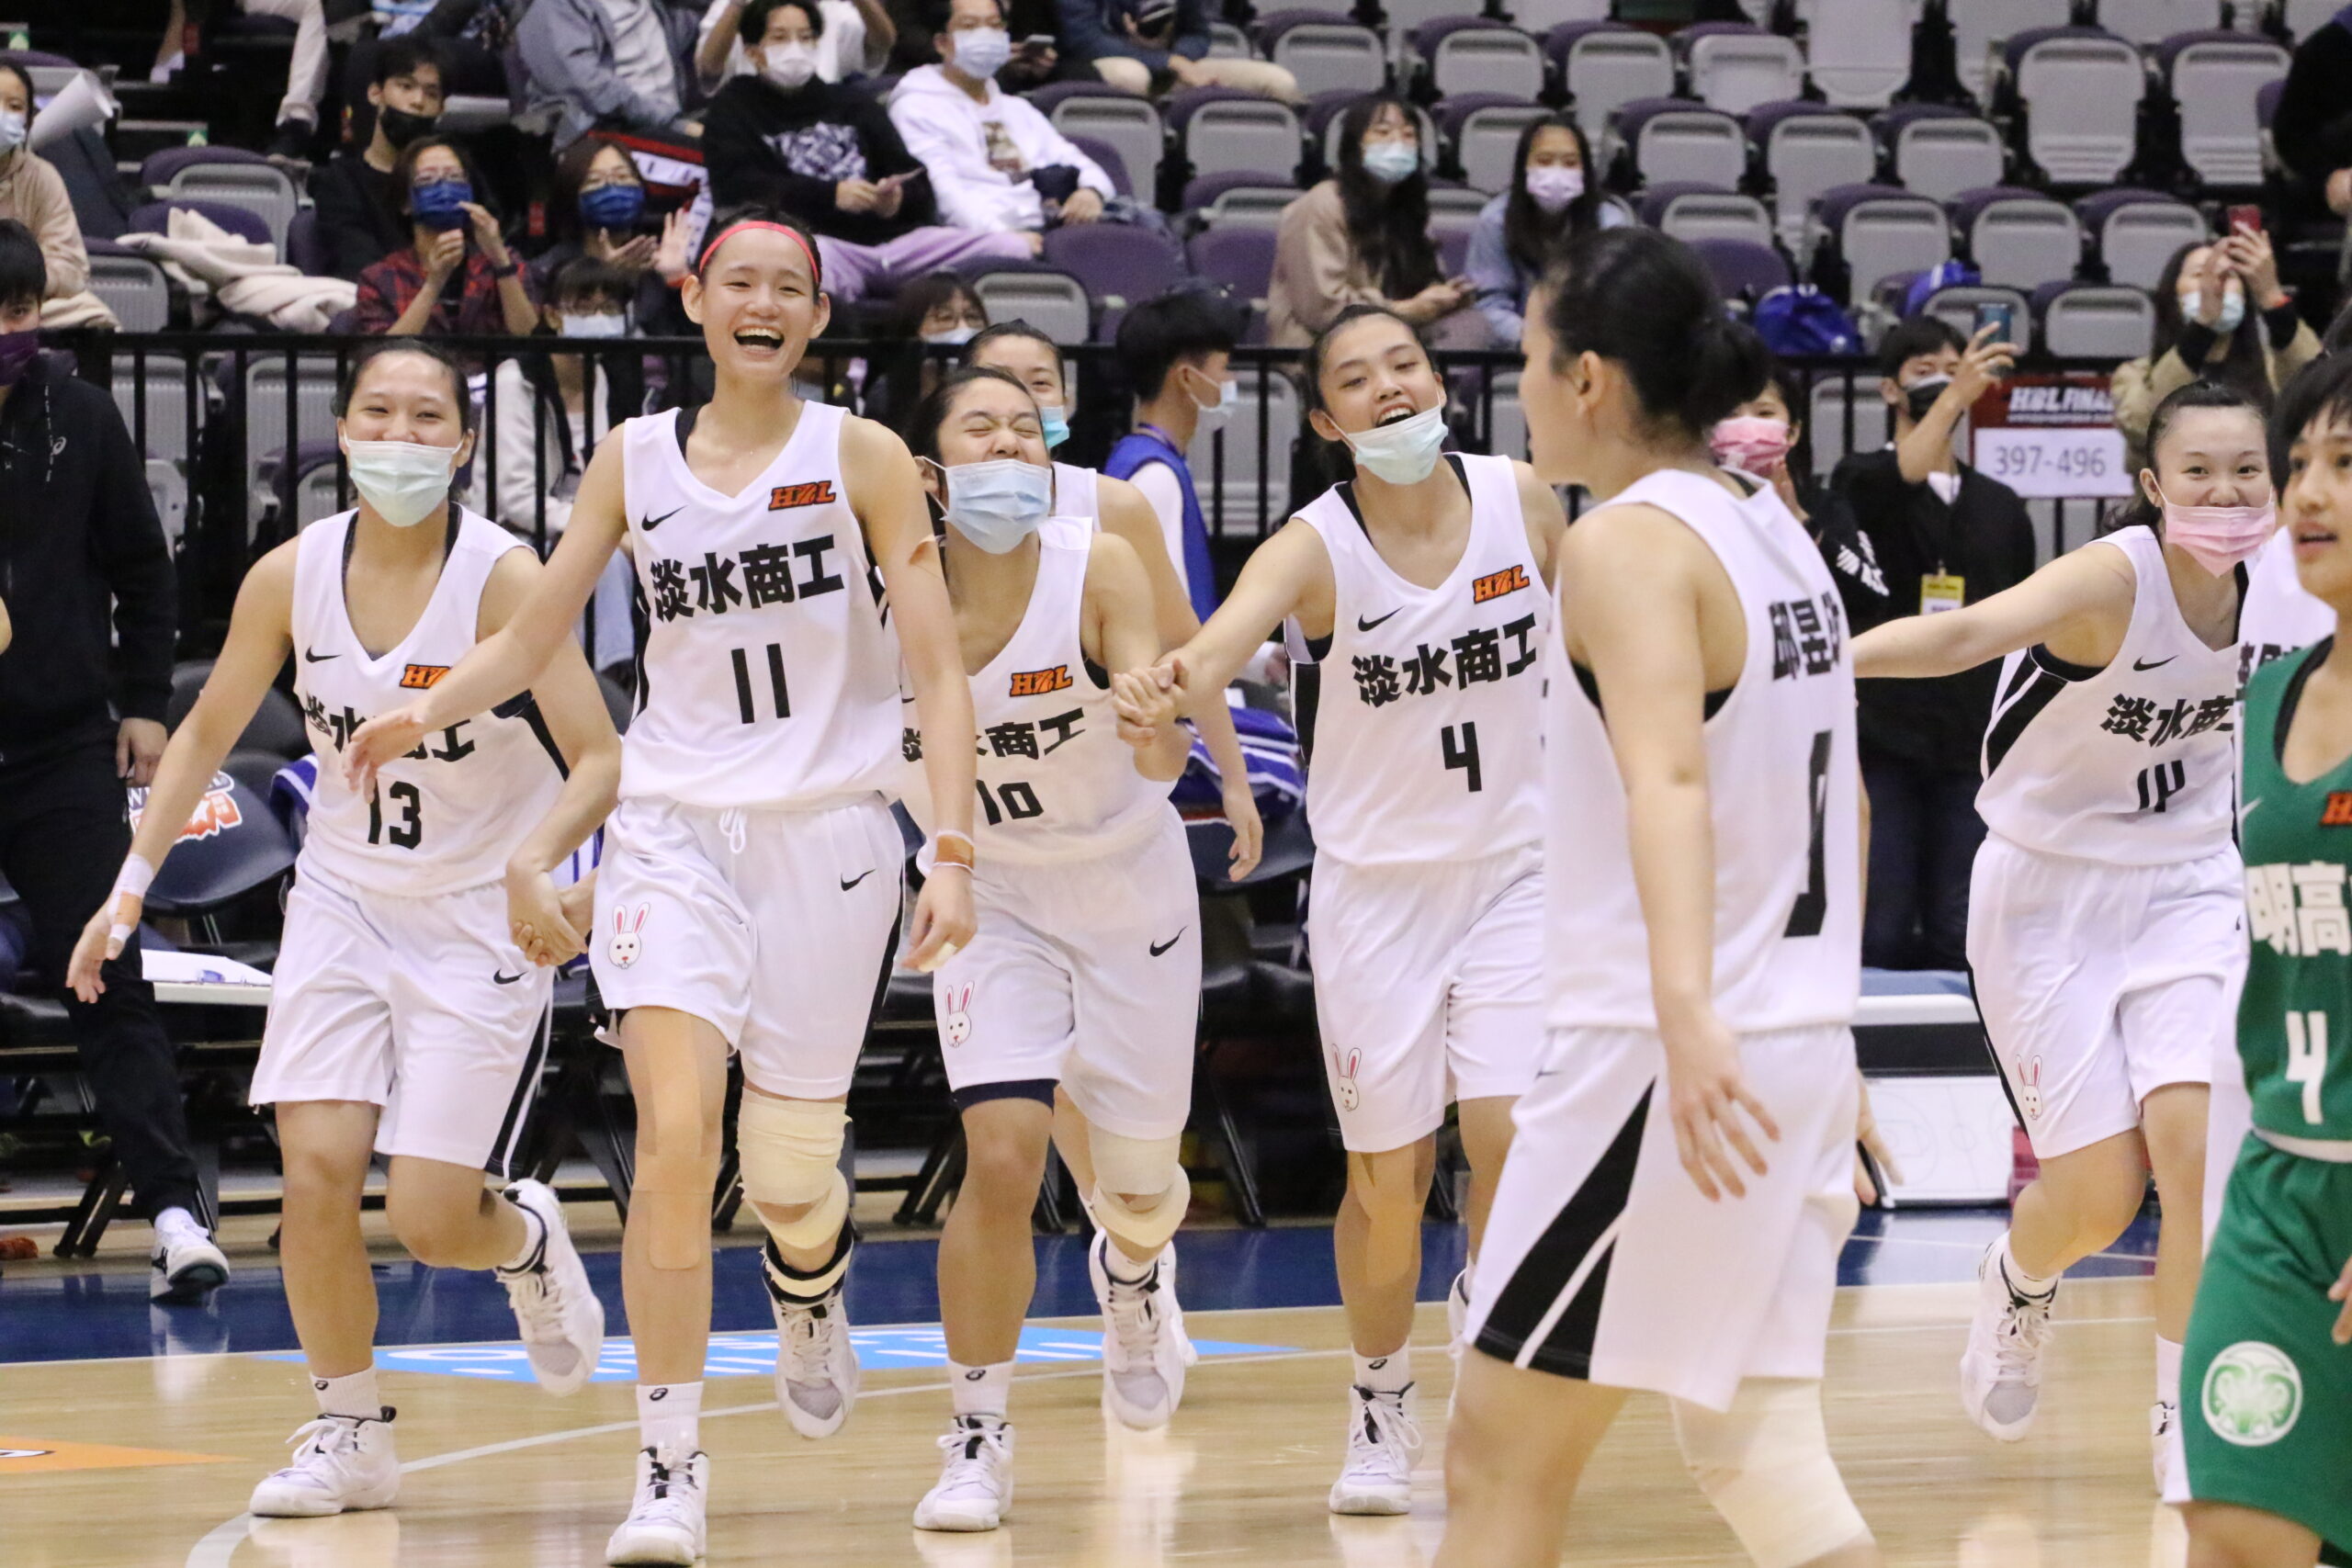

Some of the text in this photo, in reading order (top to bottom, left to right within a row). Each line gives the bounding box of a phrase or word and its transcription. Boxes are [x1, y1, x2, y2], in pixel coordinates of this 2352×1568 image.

[1994, 446, 2107, 478] 397-496
[650, 534, 845, 624] 淡水商工
[730, 643, 792, 725] 11
[1351, 612, 1538, 709] 淡水商工
[901, 706, 1087, 762] 淡商工
[1441, 720, 1483, 793] 4
[368, 777, 423, 851] 13
[976, 779, 1045, 826] 10
[2136, 759, 2187, 813] 14
[2245, 860, 2352, 956] 明高
[2285, 1010, 2328, 1125] 4
